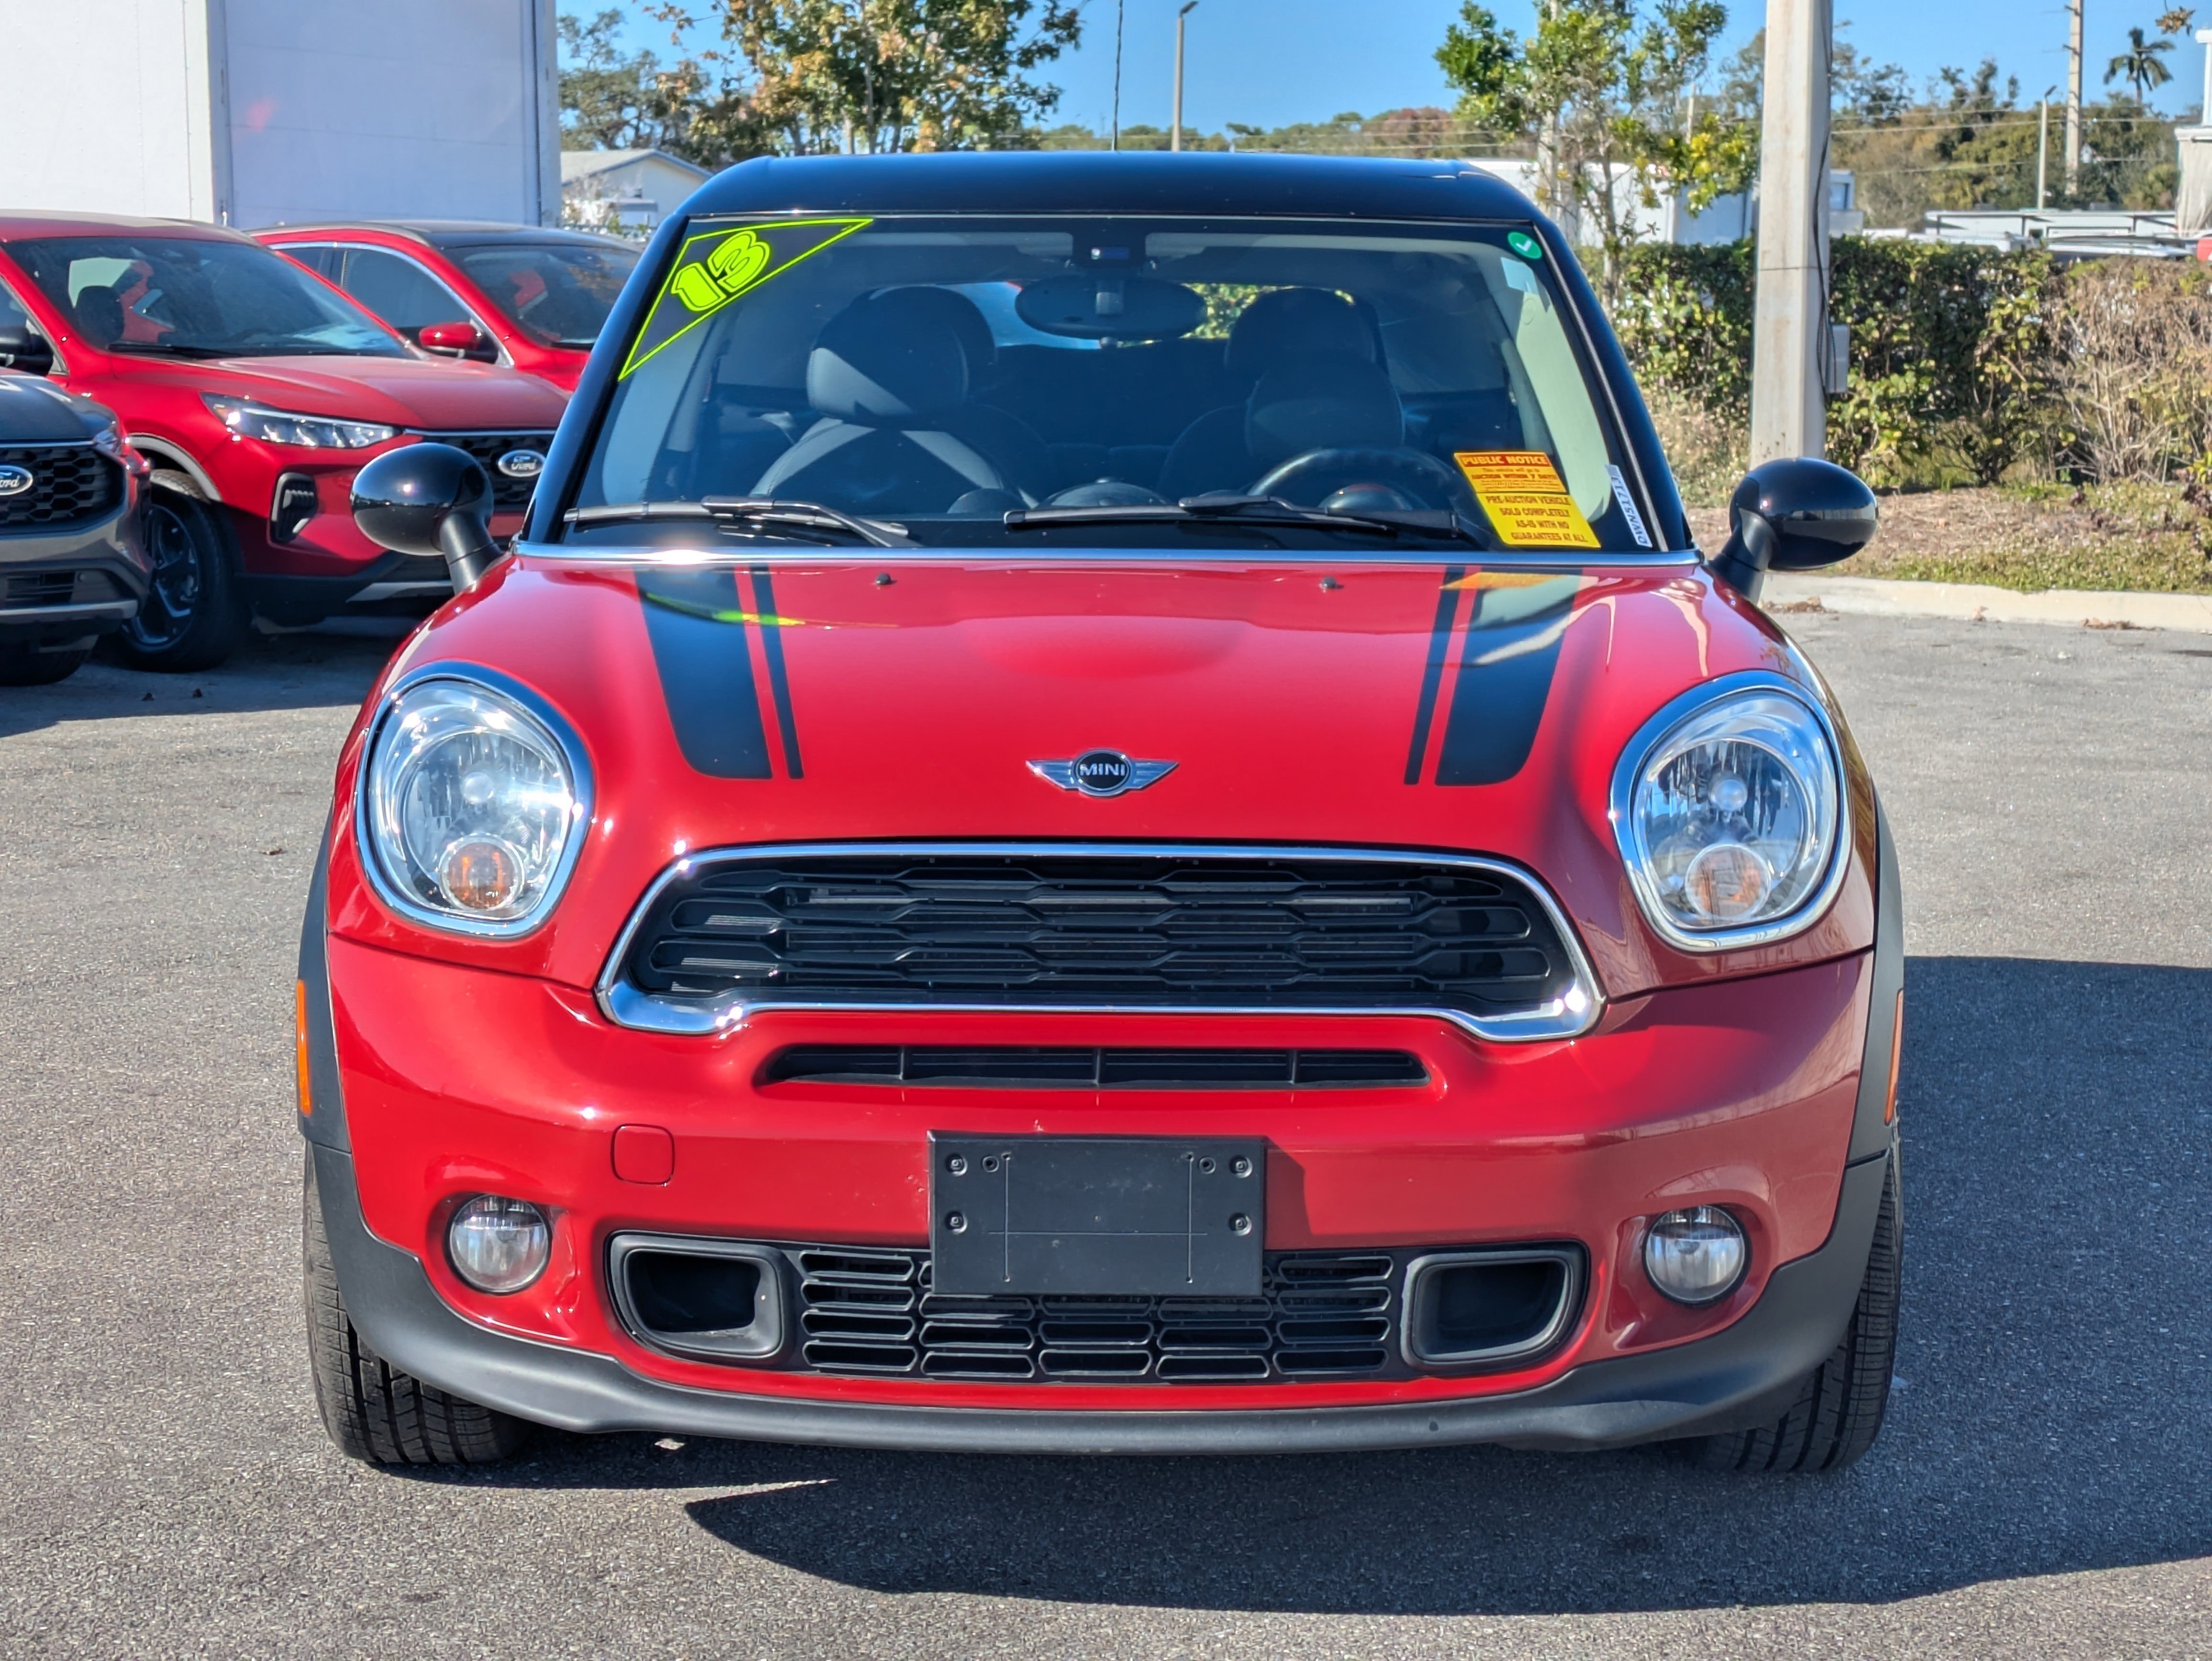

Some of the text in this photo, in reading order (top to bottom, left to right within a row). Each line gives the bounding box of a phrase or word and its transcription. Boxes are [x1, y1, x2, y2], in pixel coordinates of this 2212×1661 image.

[671, 230, 772, 312] 13
[511, 455, 537, 470] Ford
[1461, 456, 1548, 465] PUBLIC NOTICE
[1486, 496, 1571, 505] PRE-AUCTION VEHICLE
[1522, 508, 1570, 517] COMPLETELY
[1537, 520, 1557, 529] WITH
[1557, 520, 1570, 529] NO
[1511, 532, 1561, 541] GUARANTEES
[1079, 763, 1125, 776] MINI
